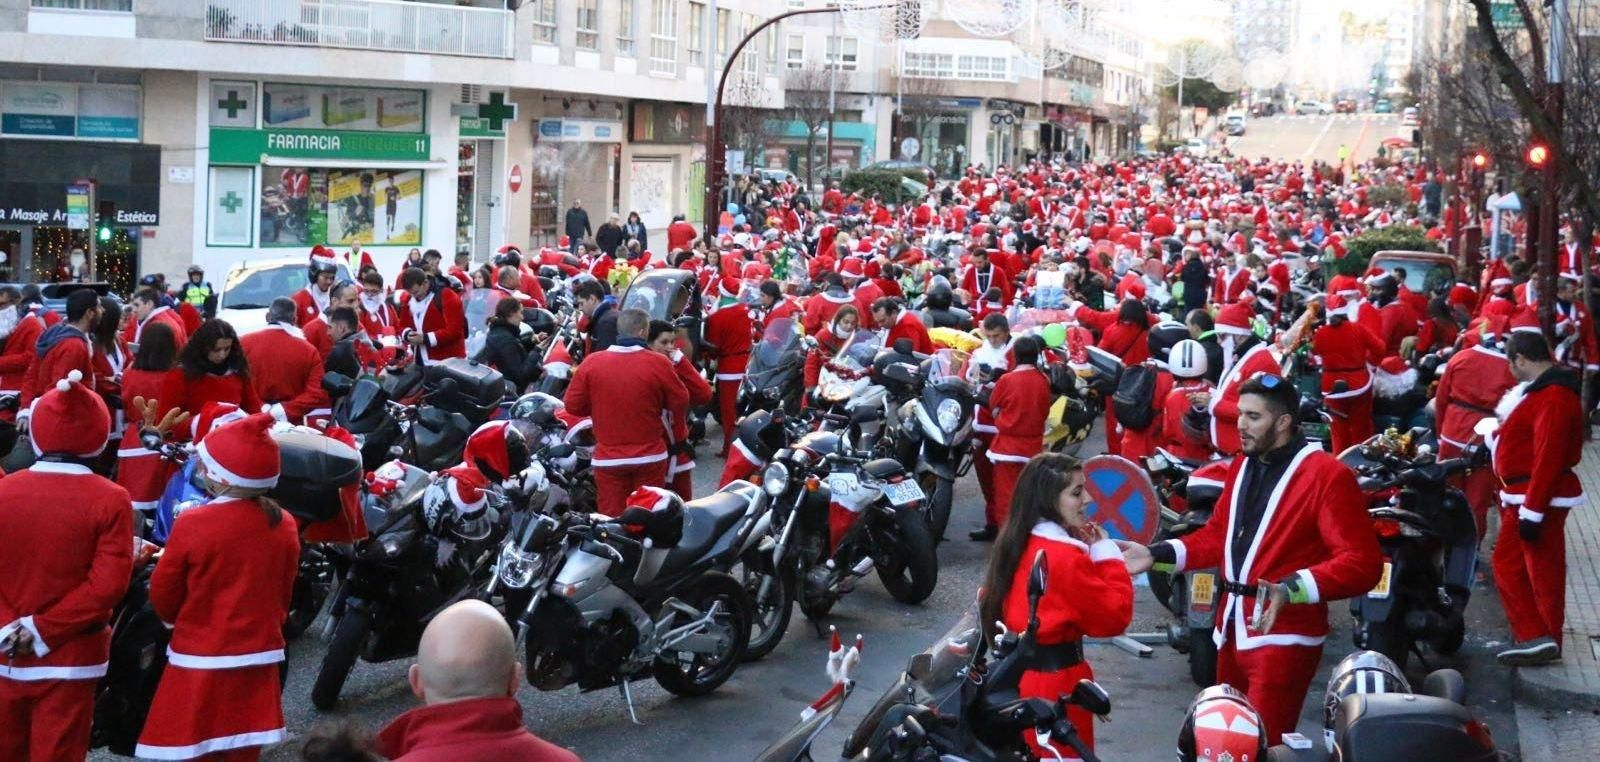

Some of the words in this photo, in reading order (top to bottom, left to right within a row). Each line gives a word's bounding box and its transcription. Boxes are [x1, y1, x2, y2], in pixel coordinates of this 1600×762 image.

[267, 133, 340, 150] FARMACIA
[341, 134, 415, 152] VENEZUELA
[415, 139, 425, 153] 11
[10, 208, 49, 223] Masaje
[117, 210, 157, 223] Estética
